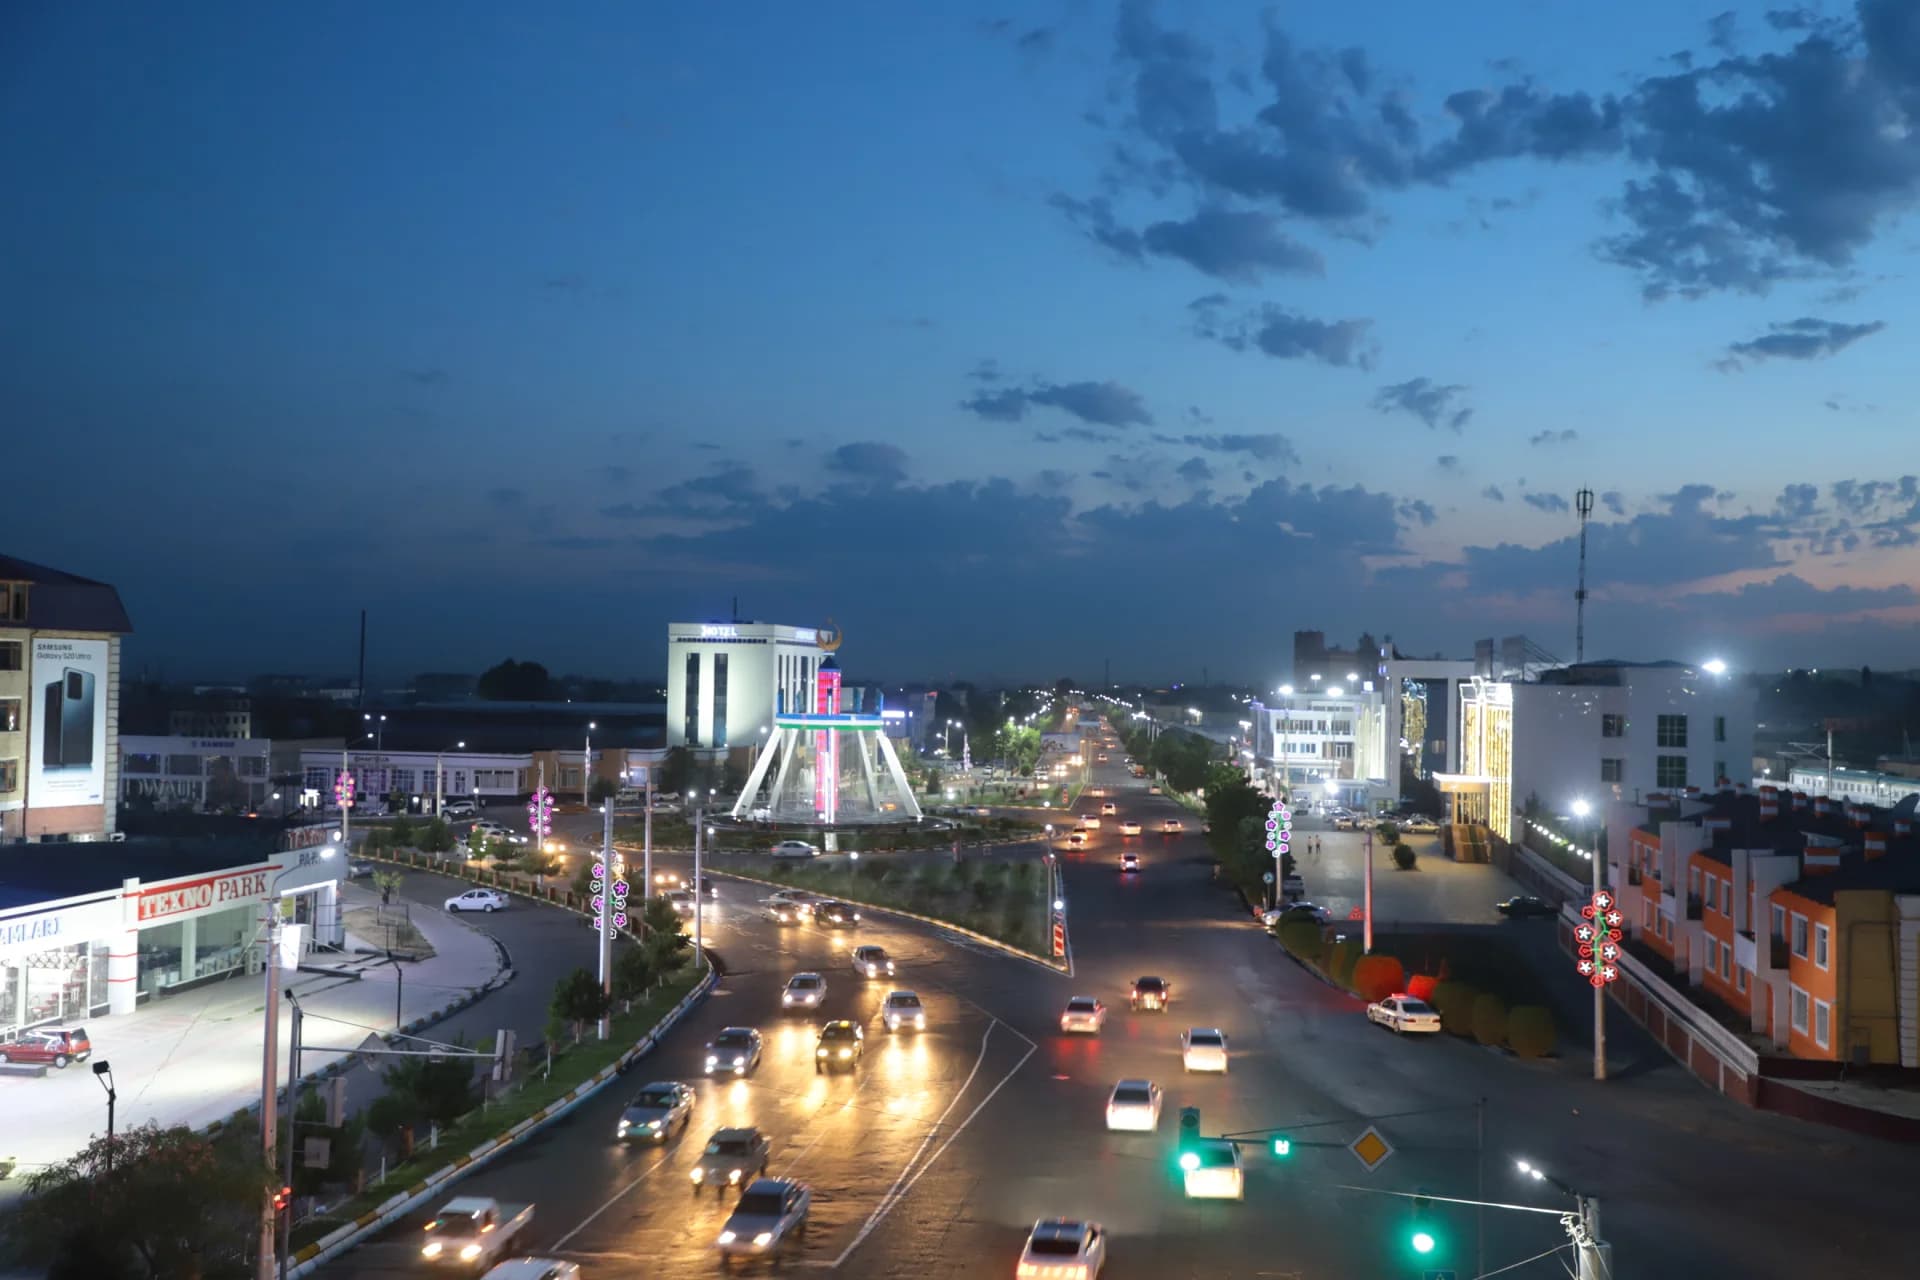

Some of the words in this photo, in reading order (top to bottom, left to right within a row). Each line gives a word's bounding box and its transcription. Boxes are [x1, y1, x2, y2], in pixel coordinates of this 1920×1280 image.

[702, 625, 737, 637] HOTEL
[37, 652, 62, 660] Galaxy
[140, 883, 212, 919] TEXNO
[218, 873, 267, 902] PARK
